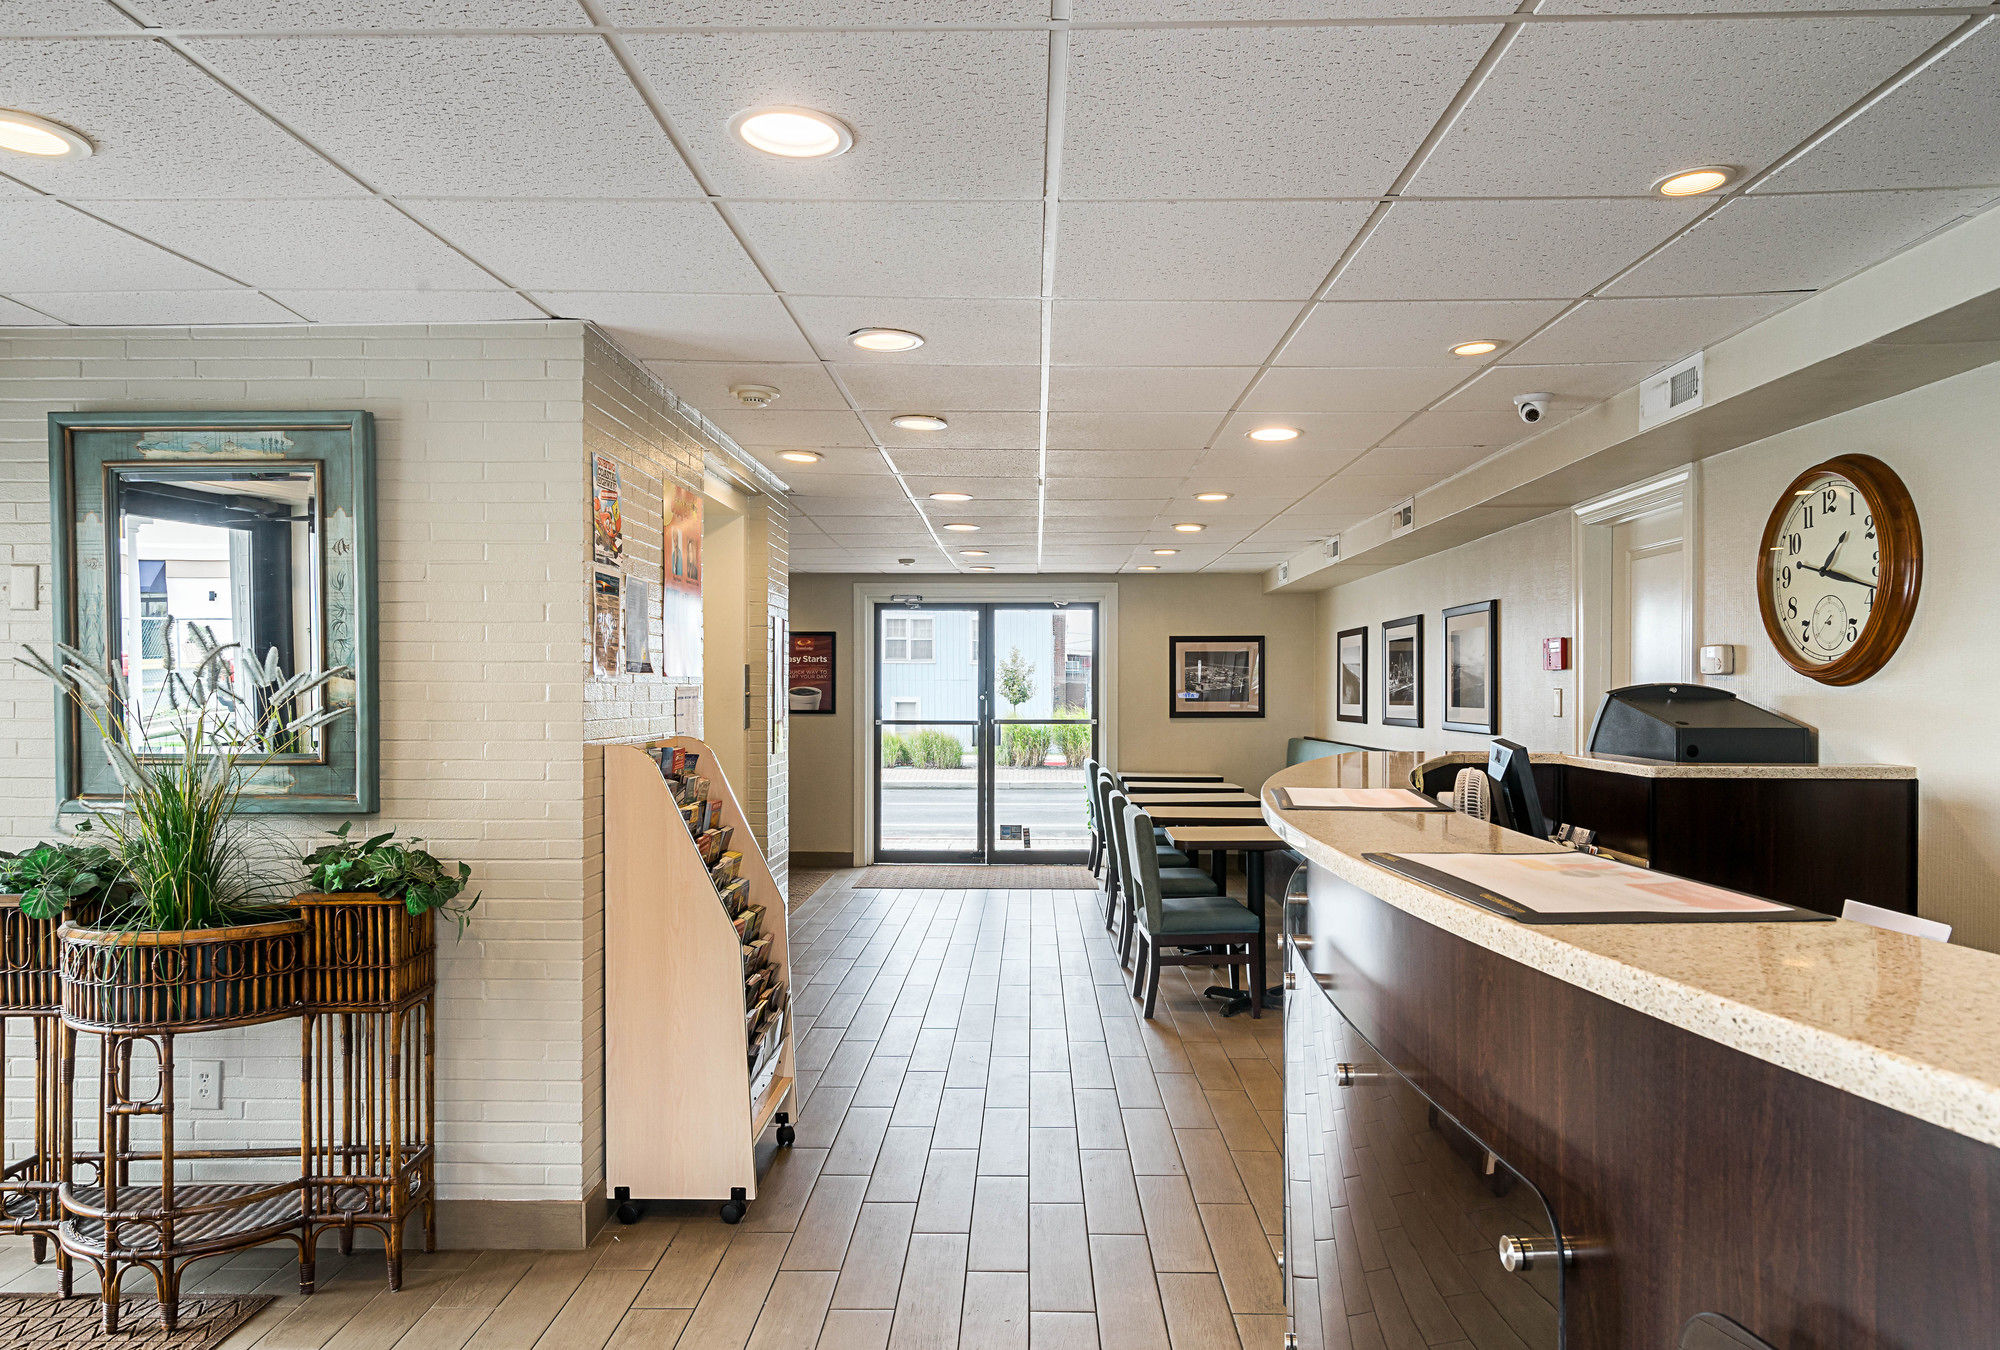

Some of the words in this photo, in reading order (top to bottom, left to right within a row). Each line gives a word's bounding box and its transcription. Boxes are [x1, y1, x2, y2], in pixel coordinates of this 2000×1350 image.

[1822, 489, 1837, 515] 12
[1850, 491, 1856, 516] 1
[1803, 505, 1814, 529] 11
[1864, 514, 1876, 540] 2
[1789, 532, 1802, 556] 10
[1782, 566, 1792, 589] 9
[1787, 596, 1798, 620] 8
[1864, 588, 1876, 613] 4
[1801, 620, 1811, 643] 7
[1847, 618, 1858, 642] 5
[789, 656, 801, 664] asy
[802, 655, 827, 663] Starts
